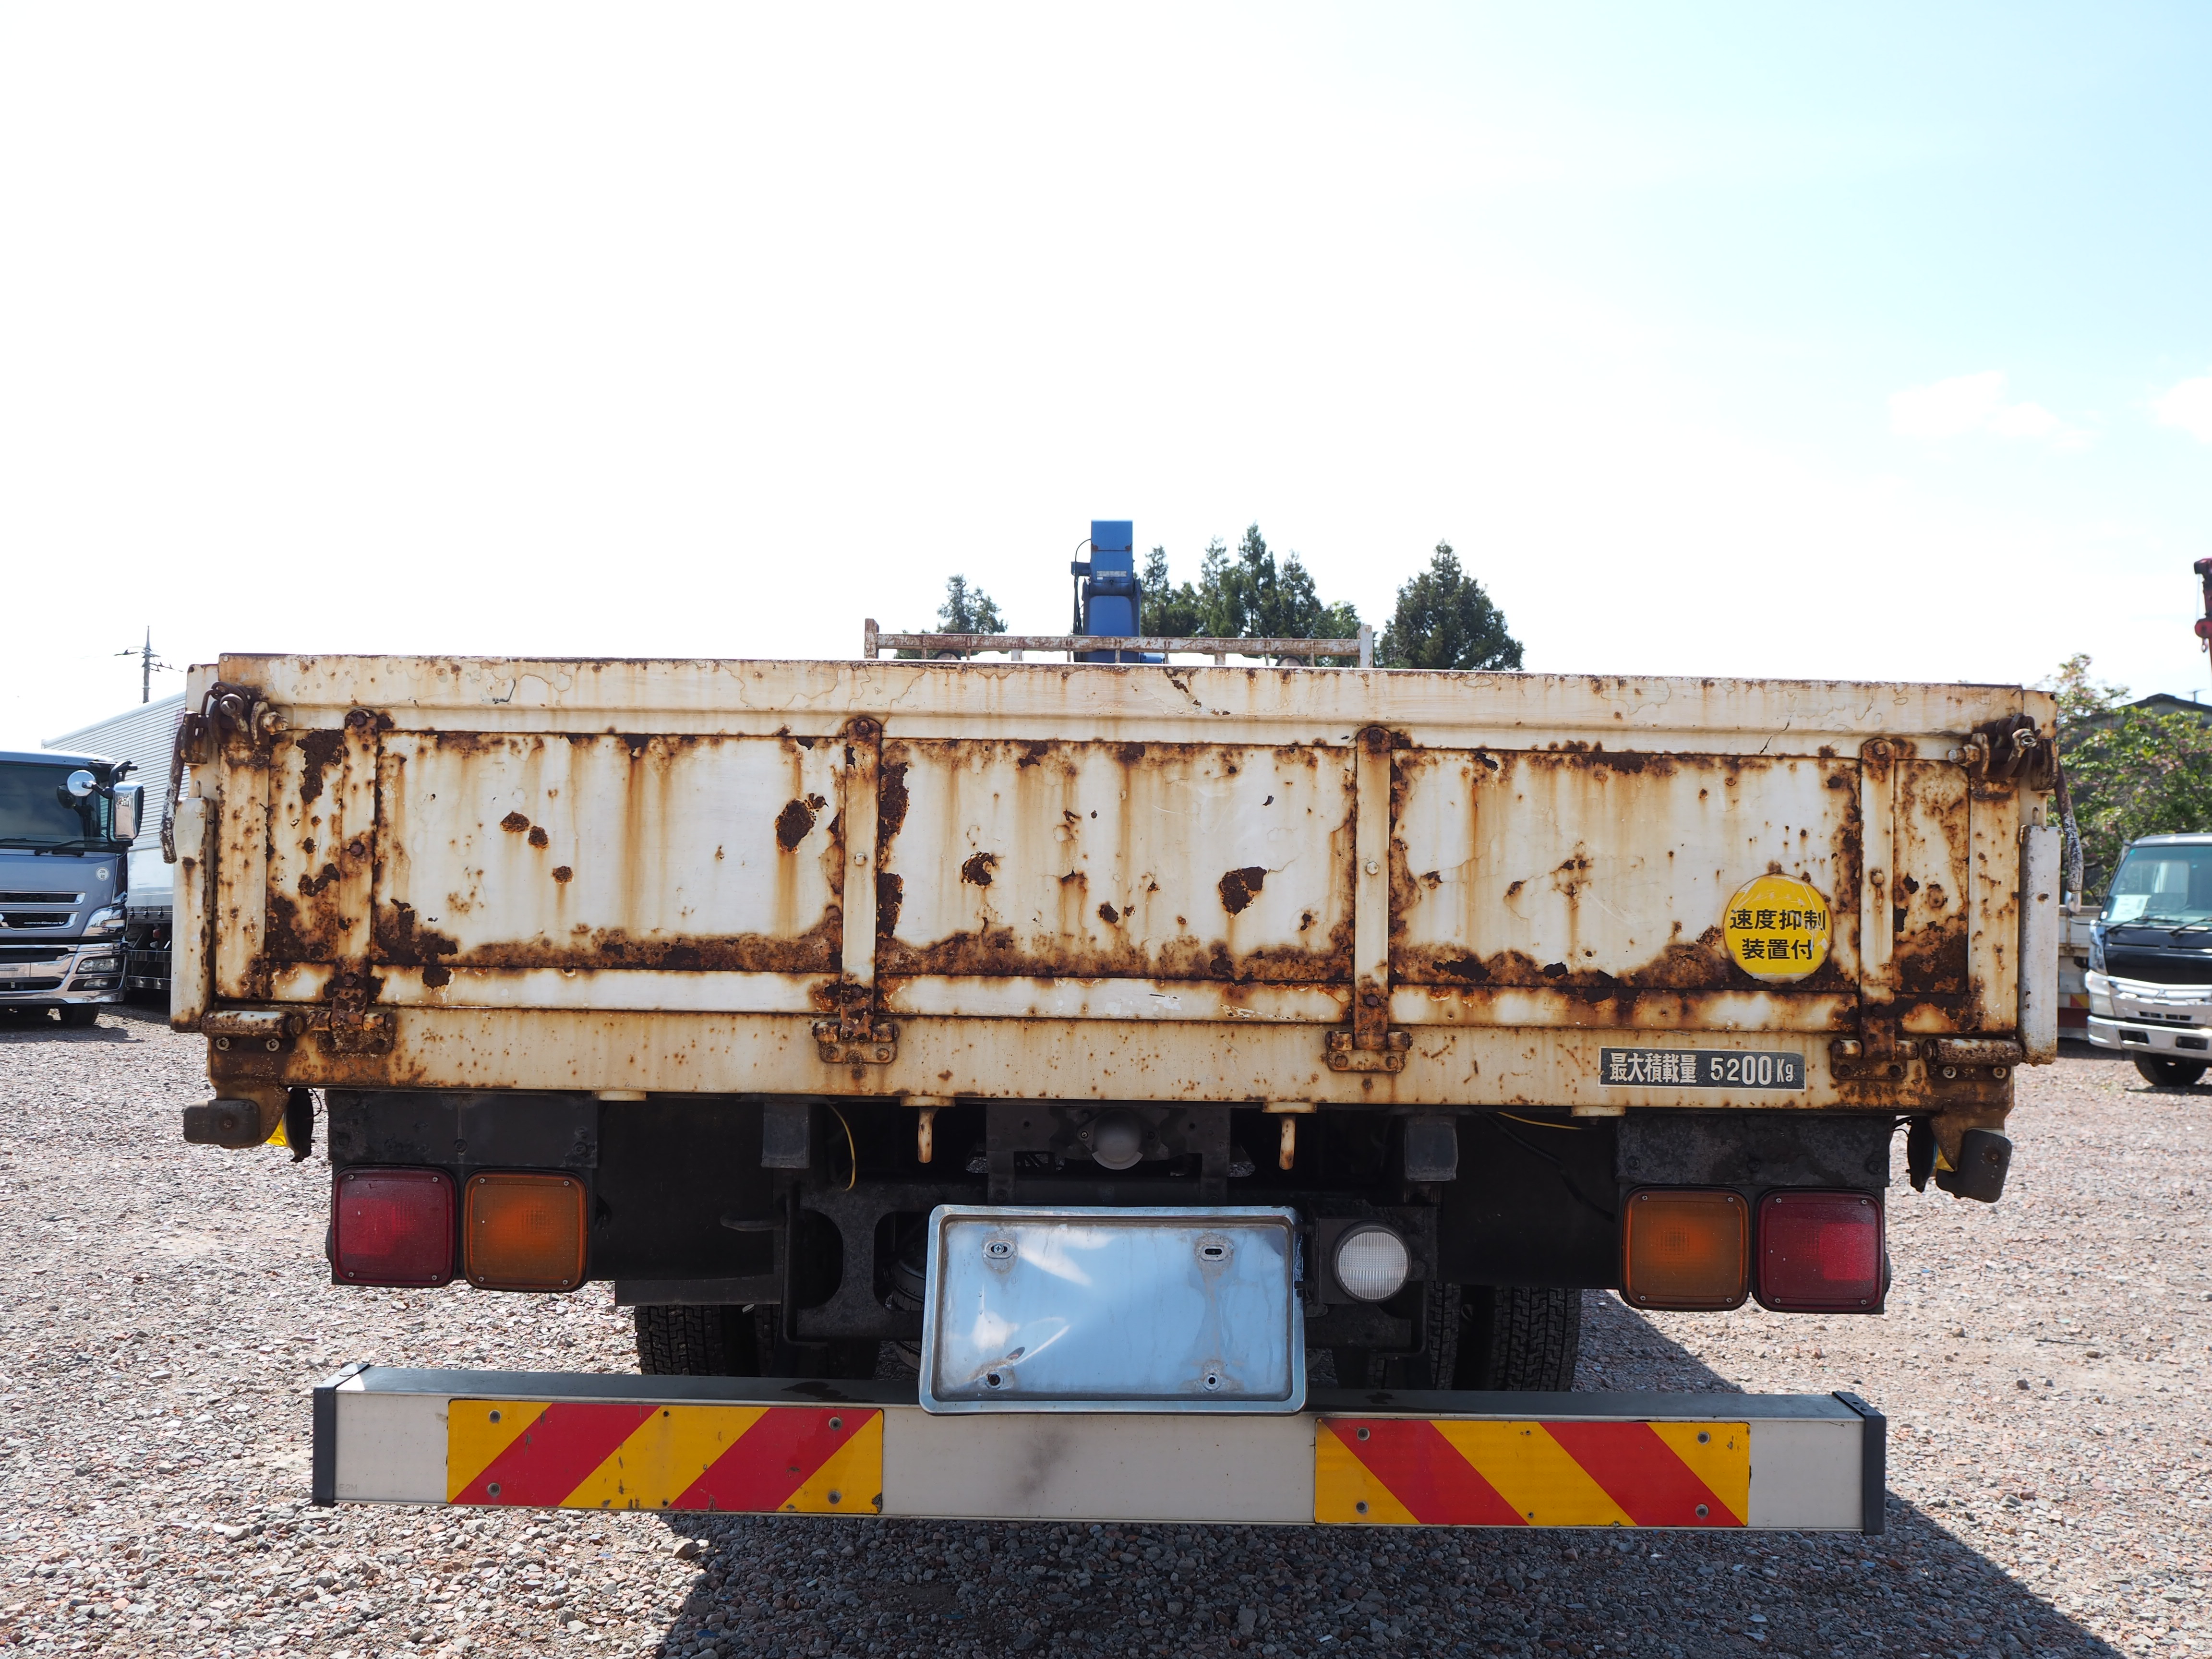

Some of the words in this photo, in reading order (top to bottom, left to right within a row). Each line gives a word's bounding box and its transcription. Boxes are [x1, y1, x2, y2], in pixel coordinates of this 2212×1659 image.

[1730, 909, 1827, 930] 速度抑制
[1742, 938, 1814, 960] 装置付
[1610, 1052, 1697, 1084] 最大積載量
